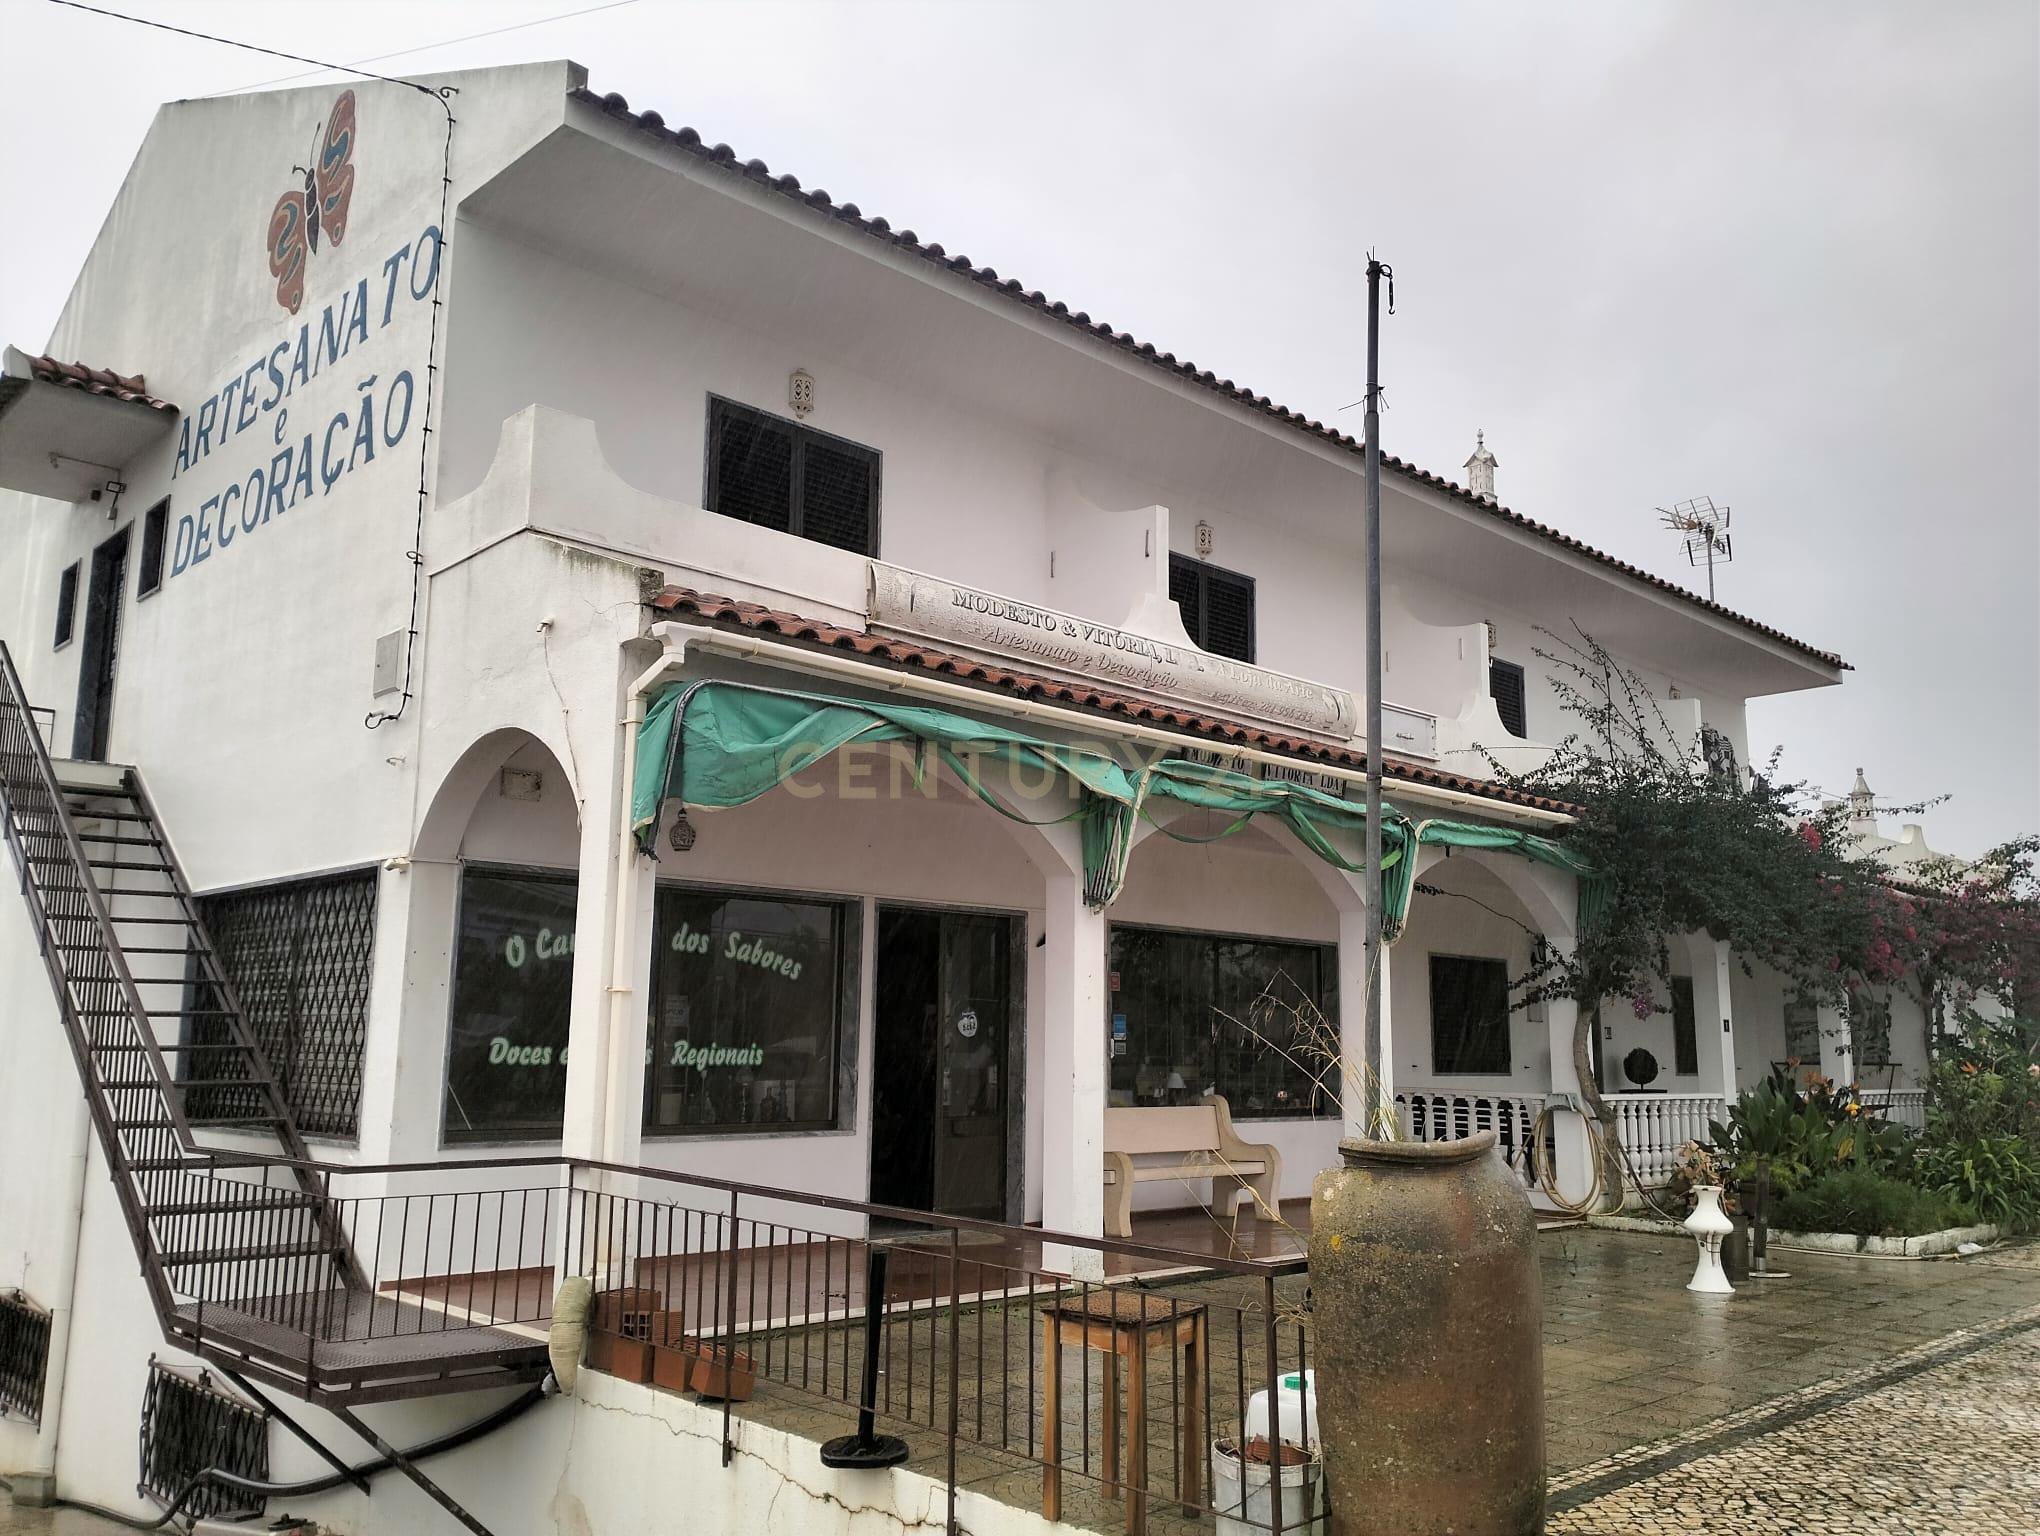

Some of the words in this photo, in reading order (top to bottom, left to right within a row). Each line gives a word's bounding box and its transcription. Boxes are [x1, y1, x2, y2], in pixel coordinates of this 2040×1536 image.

[172, 225, 442, 481] ARTESANATO
[273, 407, 288, 446] e
[171, 371, 415, 579] DECORAÇÃO
[952, 588, 1056, 632] MODESTO
[1061, 620, 1077, 637] &
[983, 625, 1079, 664] Artesanato
[1096, 652, 1179, 688] Decoração
[506, 934, 526, 968] O
[672, 922, 711, 955] dos
[725, 931, 803, 981] Sabores
[489, 1036, 552, 1067] Doces
[671, 1039, 763, 1072] Regionais
